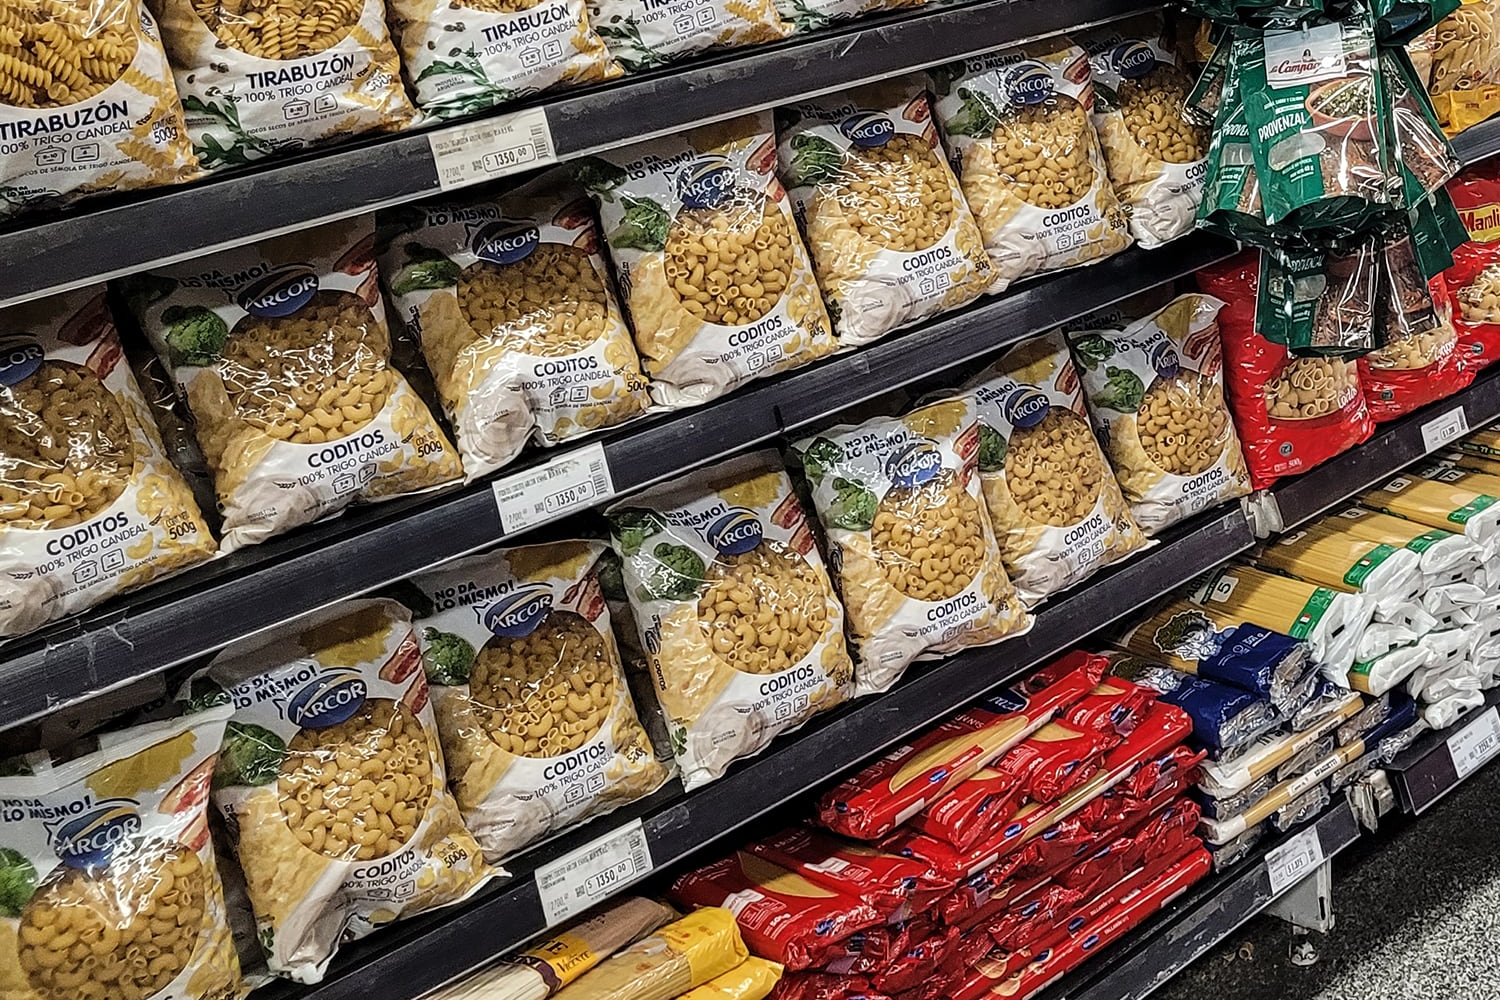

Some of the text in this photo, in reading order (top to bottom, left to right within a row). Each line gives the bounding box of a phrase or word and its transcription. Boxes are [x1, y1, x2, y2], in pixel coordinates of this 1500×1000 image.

[481, 4, 571, 42] TIRABUZÓN
[641, 10, 665, 24] 100%
[666, 0, 693, 16] TRIGO
[483, 19, 577, 57] 100% TRIGO CANDEAL
[246, 53, 355, 89] TIRABUZÓN
[1119, 49, 1154, 70] ARCOR
[245, 72, 354, 104] 100% TRIGO CANDEAL
[1009, 76, 1053, 97] ARCOR
[0, 100, 129, 139] TIRABUZÓN
[847, 120, 894, 139] ARCOR
[1258, 112, 1307, 142] PROVENZAL
[32, 120, 133, 149] TRIGO CANDEAL
[154, 128, 178, 145] 500g
[494, 147, 528, 165] 1350,00
[1042, 204, 1090, 227] CODITOS
[477, 231, 540, 256] ARCOR
[903, 245, 952, 272] CODITOS
[244, 276, 318, 310] ARCOR
[728, 315, 783, 348] CODITOS
[0, 346, 42, 372] COR
[533, 355, 598, 378] CODITOS
[522, 368, 612, 391] 100% TRIGO CANDEAL
[1008, 395, 1050, 419] ARCOR
[308, 429, 385, 468] CODITOS
[417, 442, 443, 460] 500g
[298, 440, 400, 487] 100% TRIGO CANDEAL
[556, 486, 587, 505] 1350,00
[1181, 468, 1223, 495] CODITOS
[46, 511, 129, 556] CODITOS
[169, 521, 197, 541] 500g
[714, 521, 761, 547] ARCOR
[1063, 515, 1104, 546] CODITOS
[35, 523, 148, 577] 100% TRIGO CANDEAL
[457, 579, 515, 608] MISMO!
[926, 592, 978, 622] CODITOS
[489, 595, 552, 629] ARCOR
[653, 658, 668, 692] CODITOS
[759, 664, 815, 697] CODITOS
[296, 682, 366, 719] ARCOR
[543, 741, 607, 782] CODITOS
[29, 795, 92, 822] MISMO!
[55, 819, 140, 857] ARCOR
[353, 849, 416, 879] CODITOS
[596, 864, 628, 887] 1350,00
[367, 873, 397, 888] TRIGO
